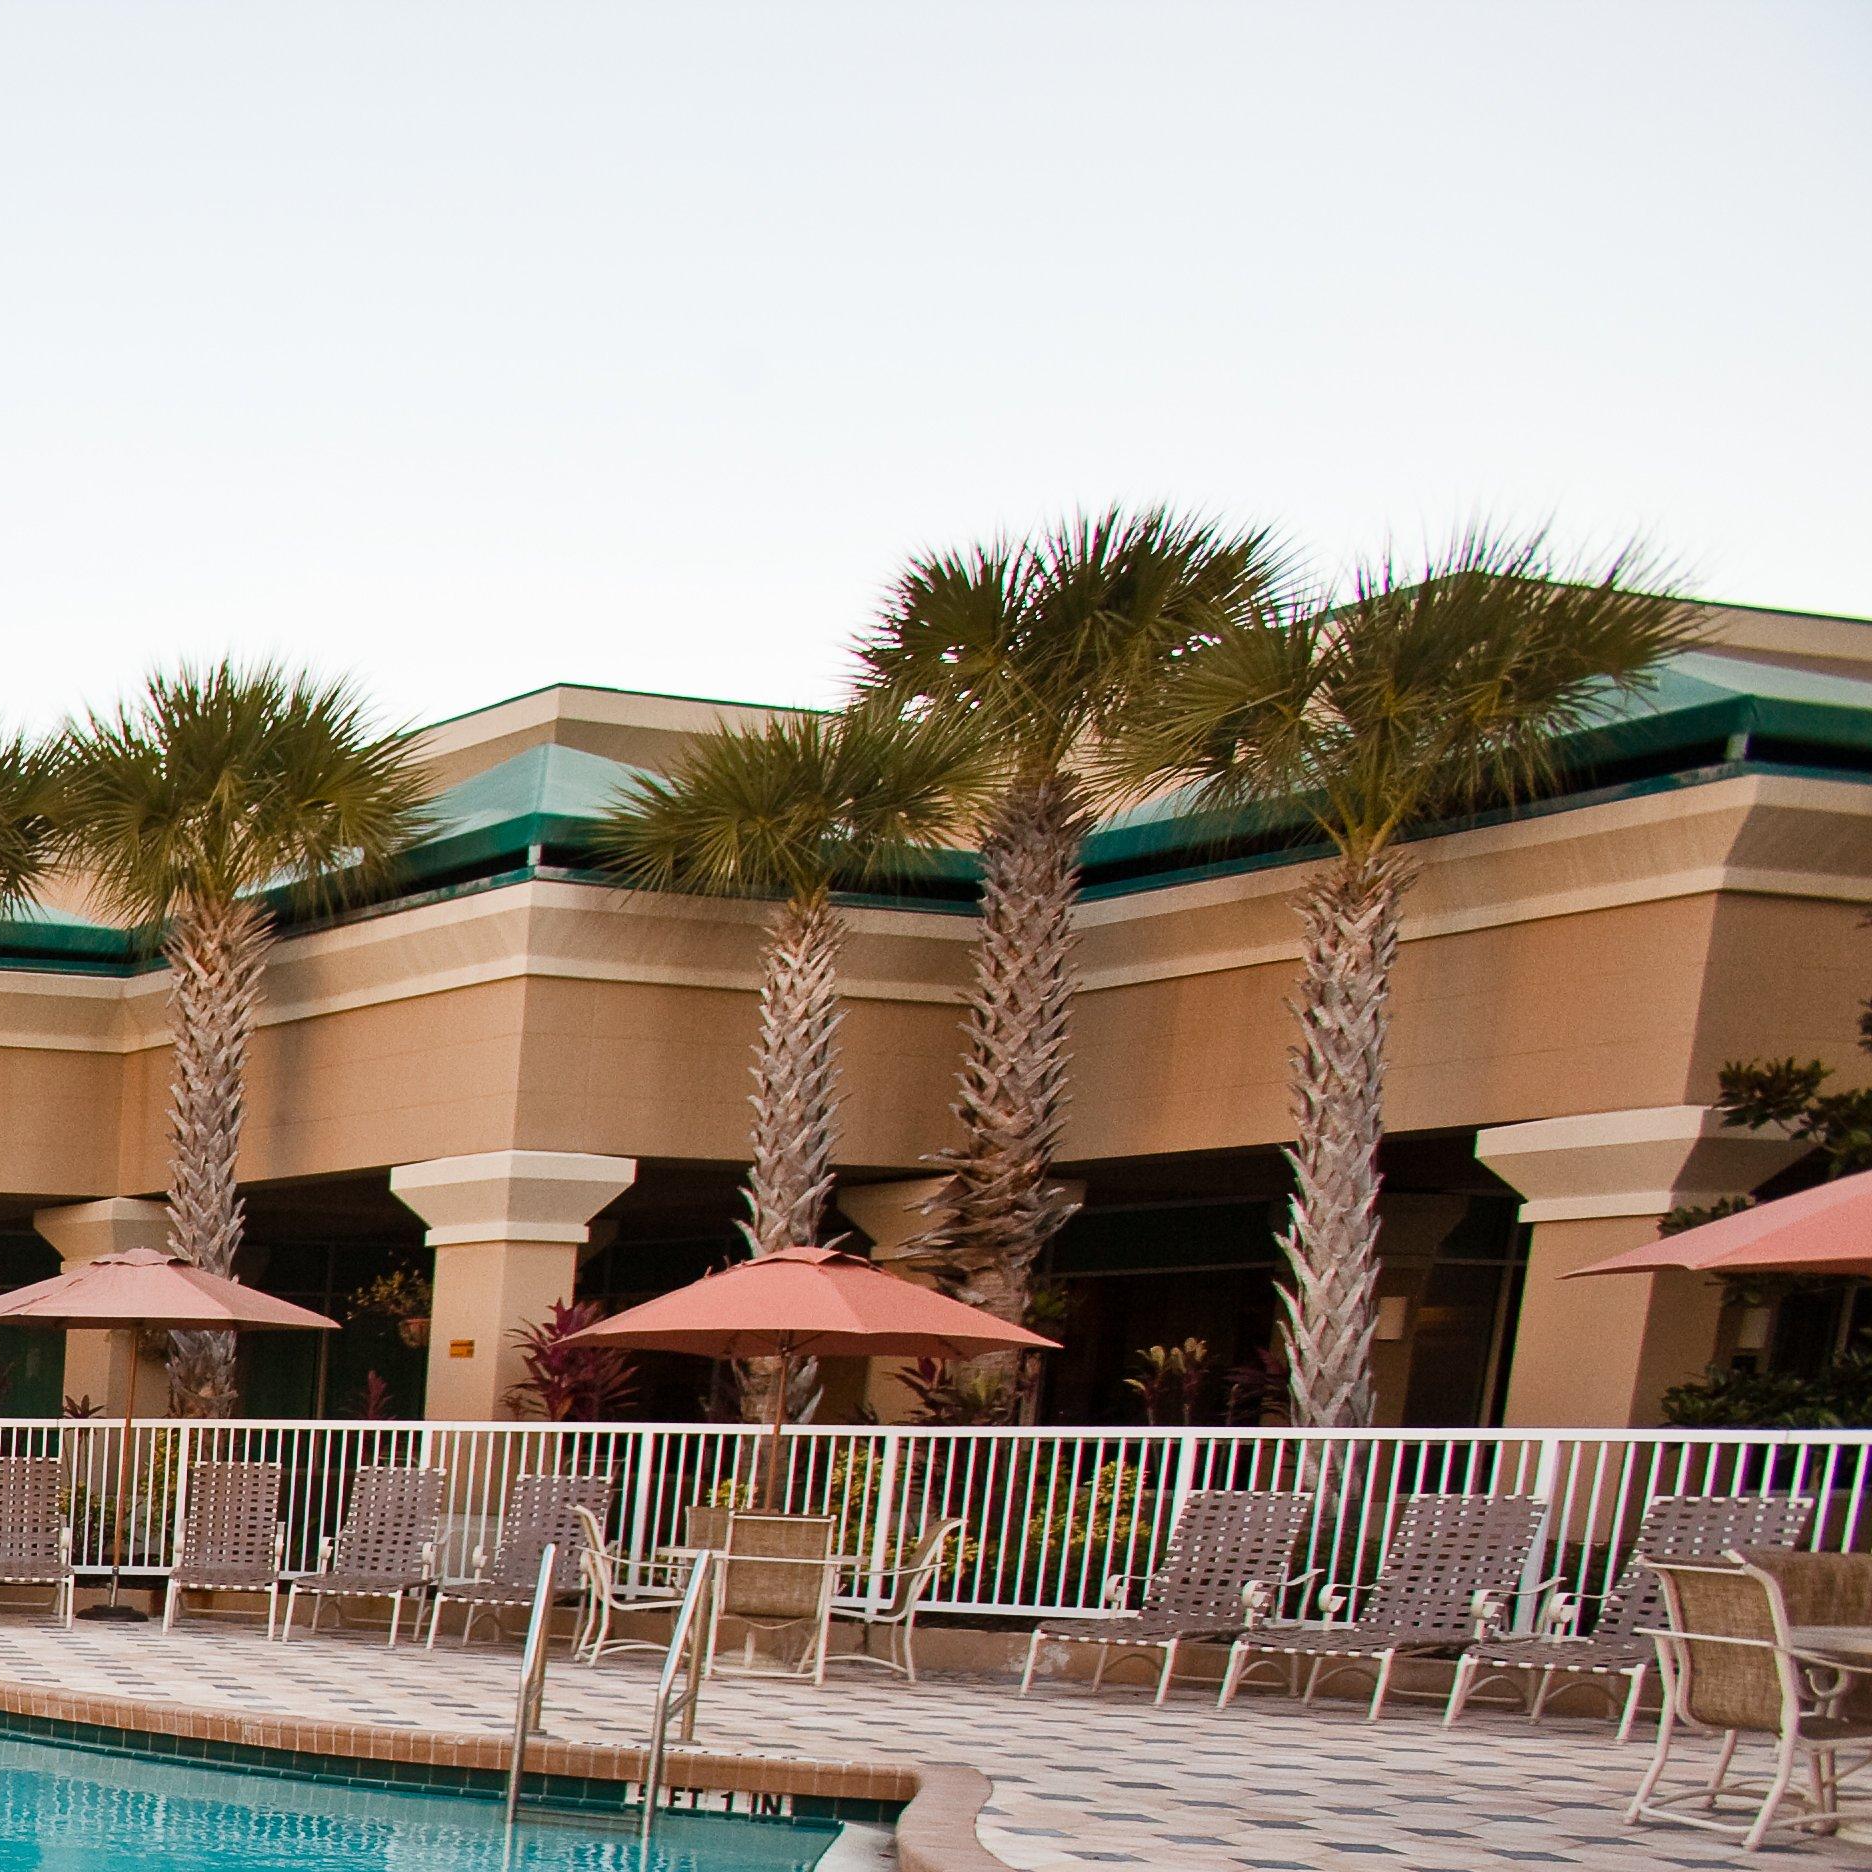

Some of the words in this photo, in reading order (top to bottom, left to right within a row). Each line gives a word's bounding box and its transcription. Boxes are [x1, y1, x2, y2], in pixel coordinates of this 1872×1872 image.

[669, 1786, 703, 1809] FT
[721, 1791, 734, 1812] 1
[751, 1792, 784, 1816] IN
